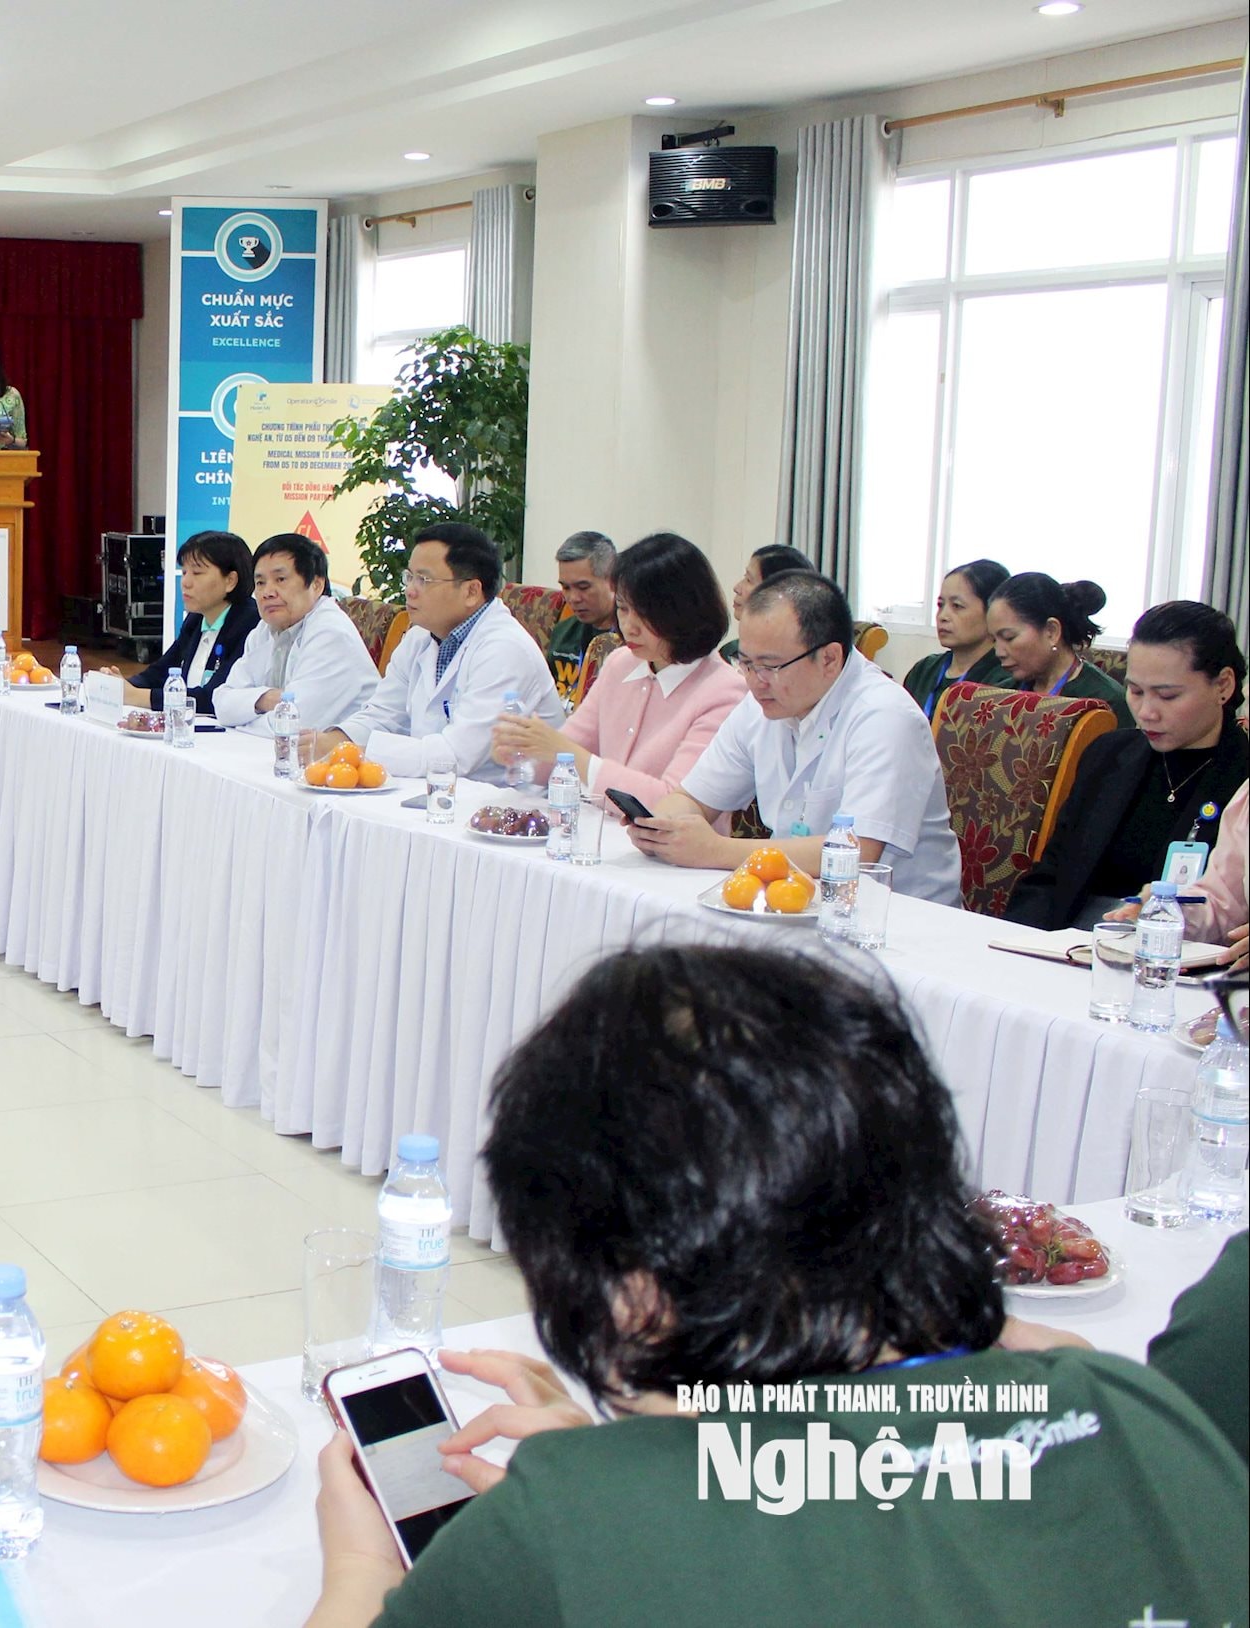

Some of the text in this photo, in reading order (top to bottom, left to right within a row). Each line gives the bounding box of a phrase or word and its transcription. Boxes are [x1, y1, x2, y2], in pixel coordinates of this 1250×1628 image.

[201, 289, 294, 310] CHUẨN MỰC
[210, 310, 284, 328] XUẤT SẮC
[212, 337, 281, 348] EXCELLENCE
[268, 450, 294, 459] MEDICAL
[295, 450, 320, 459] MISSION
[263, 461, 280, 469] FROM
[195, 469, 233, 484] CHÍN
[418, 1238, 445, 1251] true
